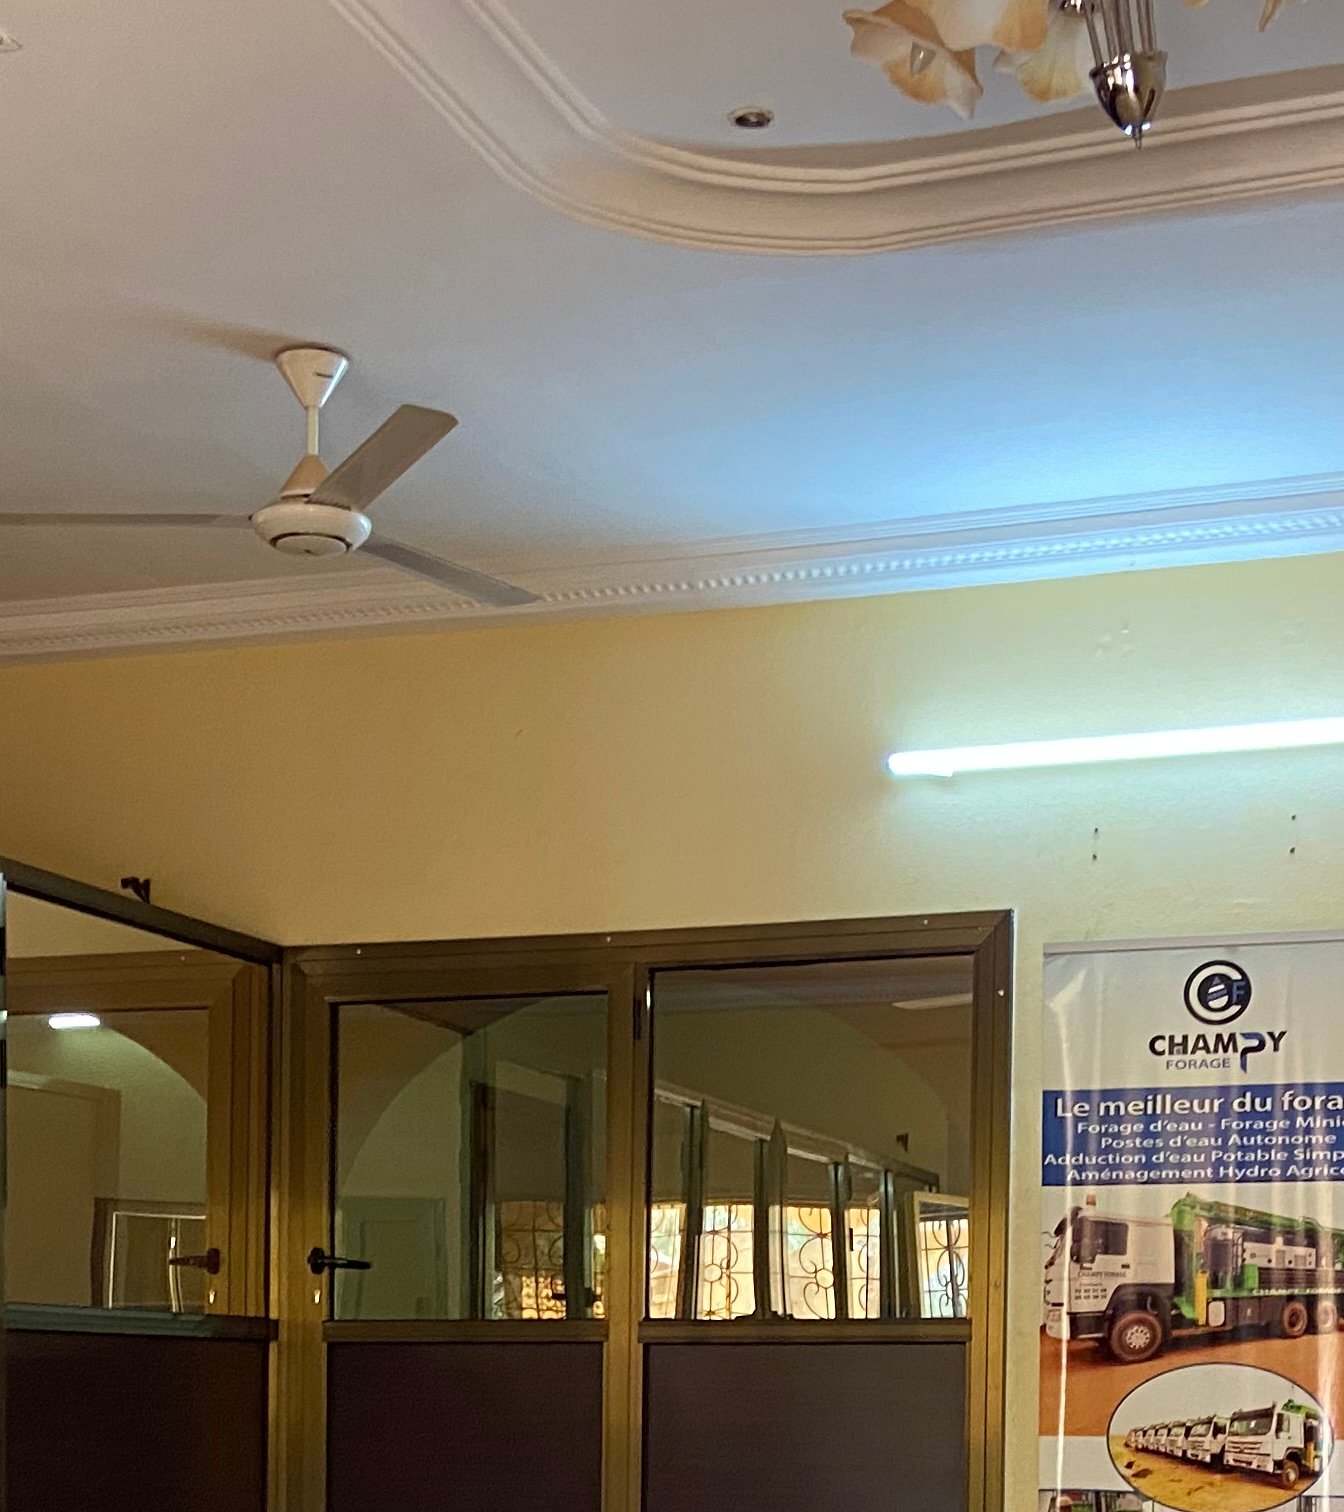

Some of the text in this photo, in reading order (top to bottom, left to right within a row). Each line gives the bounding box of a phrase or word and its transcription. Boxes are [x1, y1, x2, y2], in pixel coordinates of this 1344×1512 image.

[1149, 1031, 1287, 1073] CHAMPY
[1166, 1058, 1231, 1070] FORAGE
[1057, 1098, 1090, 1117] Le
[1099, 1094, 1224, 1116] meilleur
[1232, 1092, 1272, 1112] du
[1077, 1122, 1144, 1135] Forage
[1150, 1120, 1202, 1132] d'eau
[1221, 1119, 1290, 1132] Forage
[1101, 1133, 1336, 1149] Postes d'eau Autonome
[1044, 1153, 1146, 1165] Adduction
[1152, 1151, 1205, 1163] d'eau
[1211, 1149, 1288, 1162] Potable
[1067, 1168, 1213, 1182] Aménagement
[1219, 1165, 1281, 1180] Hydro
